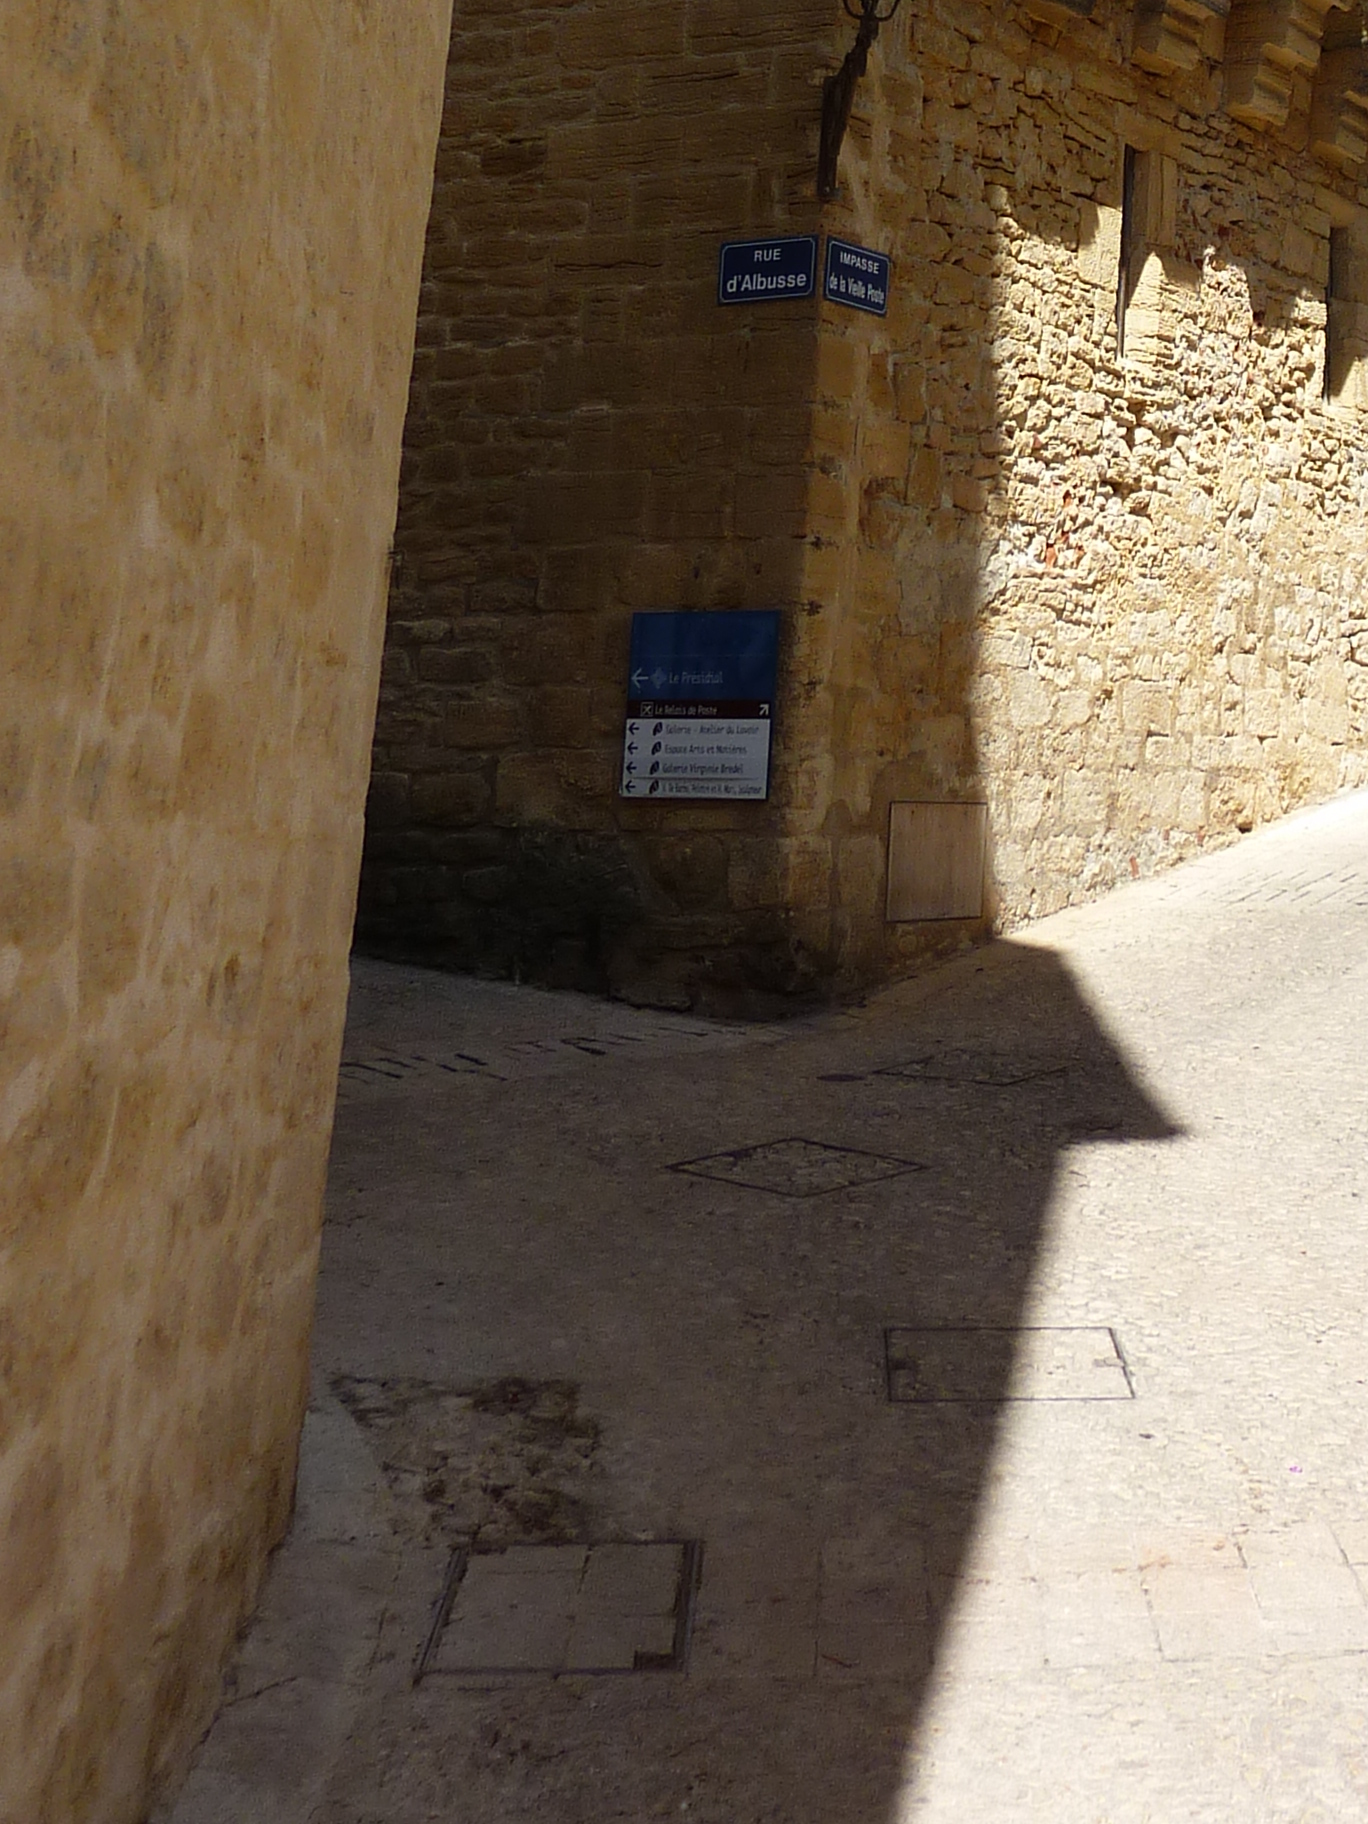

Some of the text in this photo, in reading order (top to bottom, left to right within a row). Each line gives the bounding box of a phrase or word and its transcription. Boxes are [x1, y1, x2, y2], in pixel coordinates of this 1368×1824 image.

[754, 248, 782, 262] RUE
[839, 251, 880, 274] IMPASSE
[726, 273, 807, 293] d'Albusse
[829, 272, 838, 290] de
[839, 274, 846, 292] la
[867, 283, 885, 305] Poste
[669, 671, 679, 684] Le
[655, 703, 663, 715] Le
[698, 704, 718, 716] Poste
